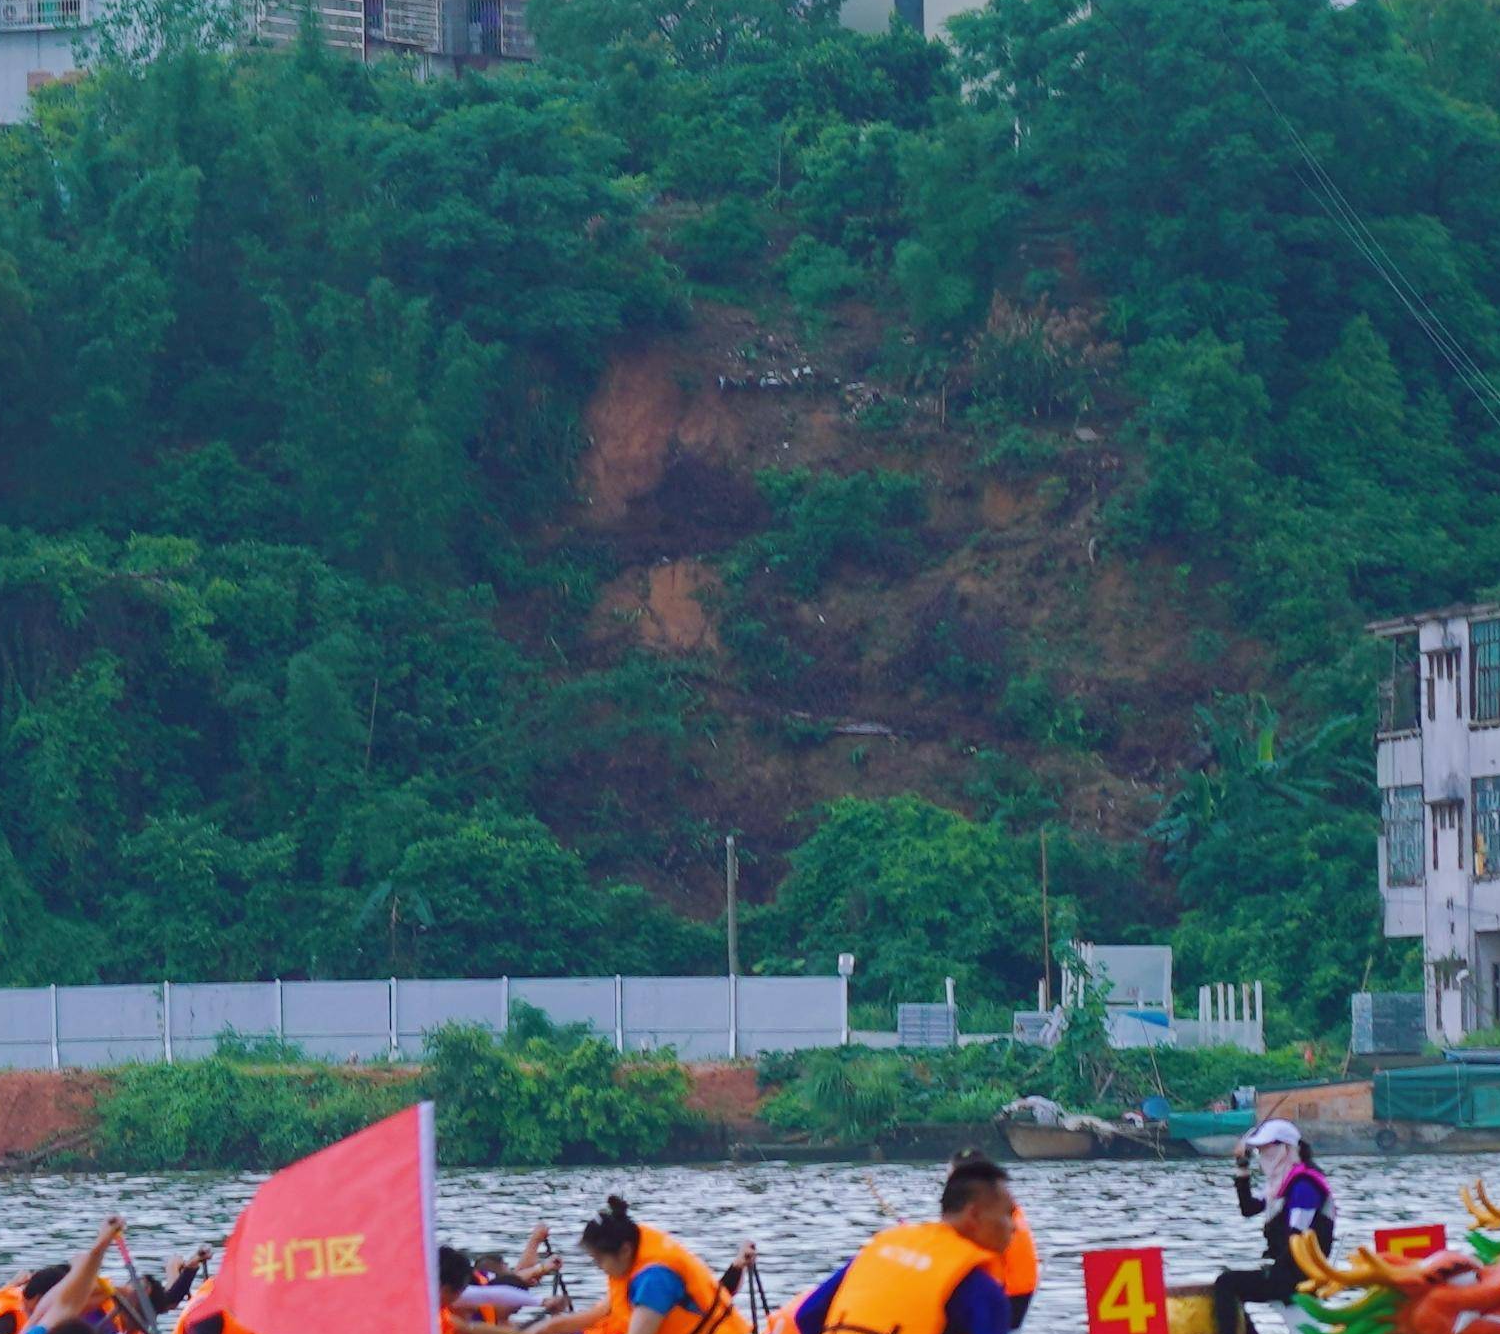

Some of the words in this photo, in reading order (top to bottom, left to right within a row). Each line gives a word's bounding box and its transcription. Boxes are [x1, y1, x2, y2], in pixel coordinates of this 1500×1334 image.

[252, 1233, 368, 1283] 斗门区
[1099, 1259, 1157, 1334] 4
